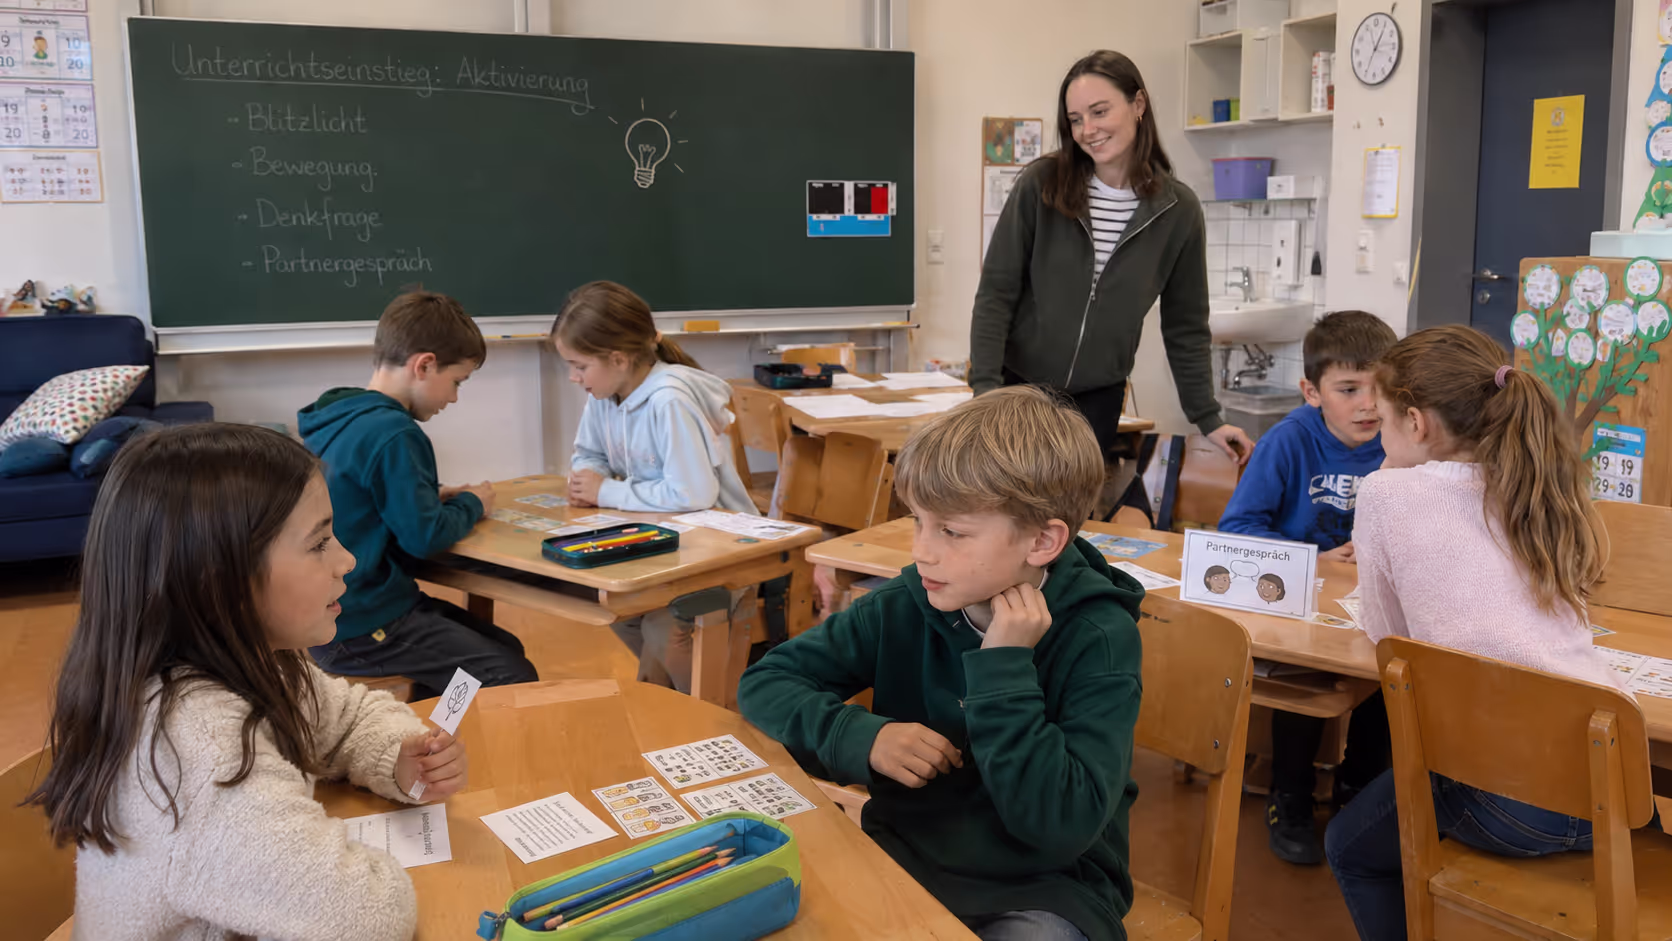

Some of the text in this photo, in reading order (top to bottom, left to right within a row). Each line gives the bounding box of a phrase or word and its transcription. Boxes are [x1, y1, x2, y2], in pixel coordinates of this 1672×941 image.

[171, 43, 592, 114] Unterrichtseinstieg: Aktivierung
[4, 128, 22, 138] 20
[246, 101, 368, 134] Blitzlicht
[72, 129, 89, 140] 20
[256, 197, 384, 242] Denkfrage
[261, 245, 433, 287] Partnergespräch
[1206, 541, 1291, 562] Partnergespräch
